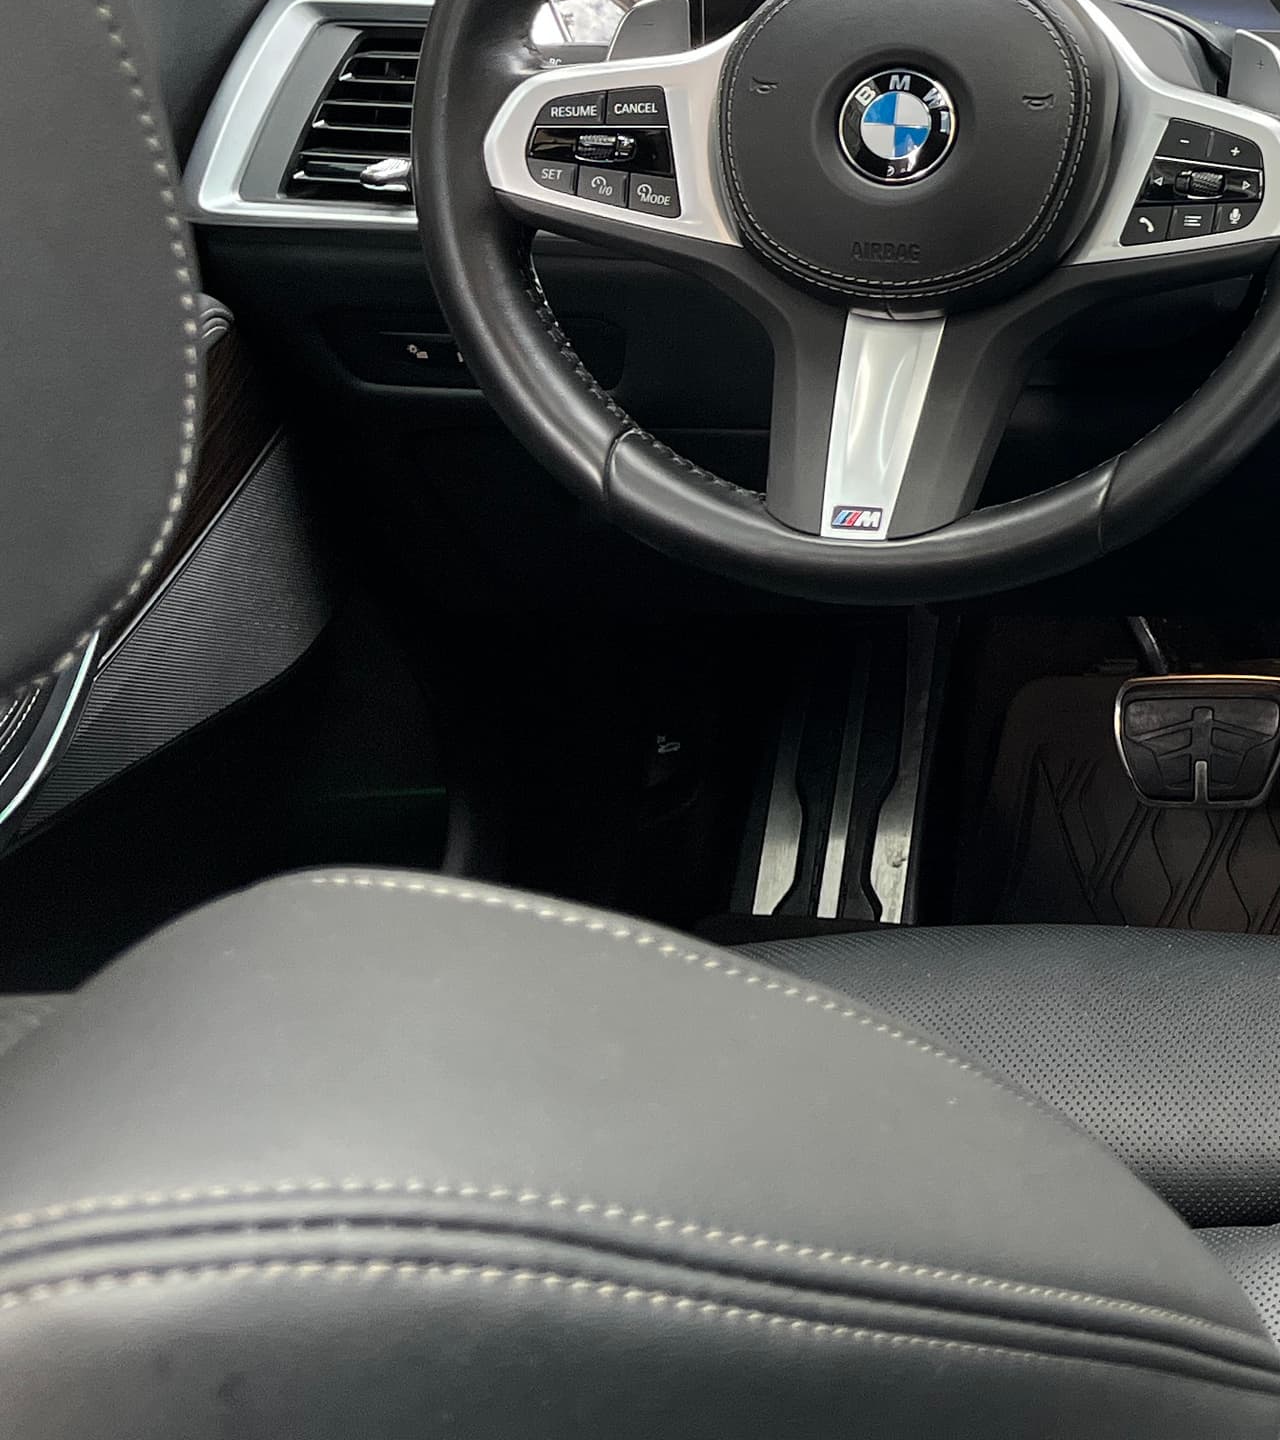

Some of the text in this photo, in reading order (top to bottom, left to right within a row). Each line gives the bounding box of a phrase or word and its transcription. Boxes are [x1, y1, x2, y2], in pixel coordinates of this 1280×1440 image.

[854, 74, 949, 109] BMW
[550, 104, 598, 118] RESUME
[614, 102, 659, 115] CANCEL
[541, 168, 563, 180] SET
[640, 191, 672, 206] MODE
[851, 240, 922, 264] AIRBAG
